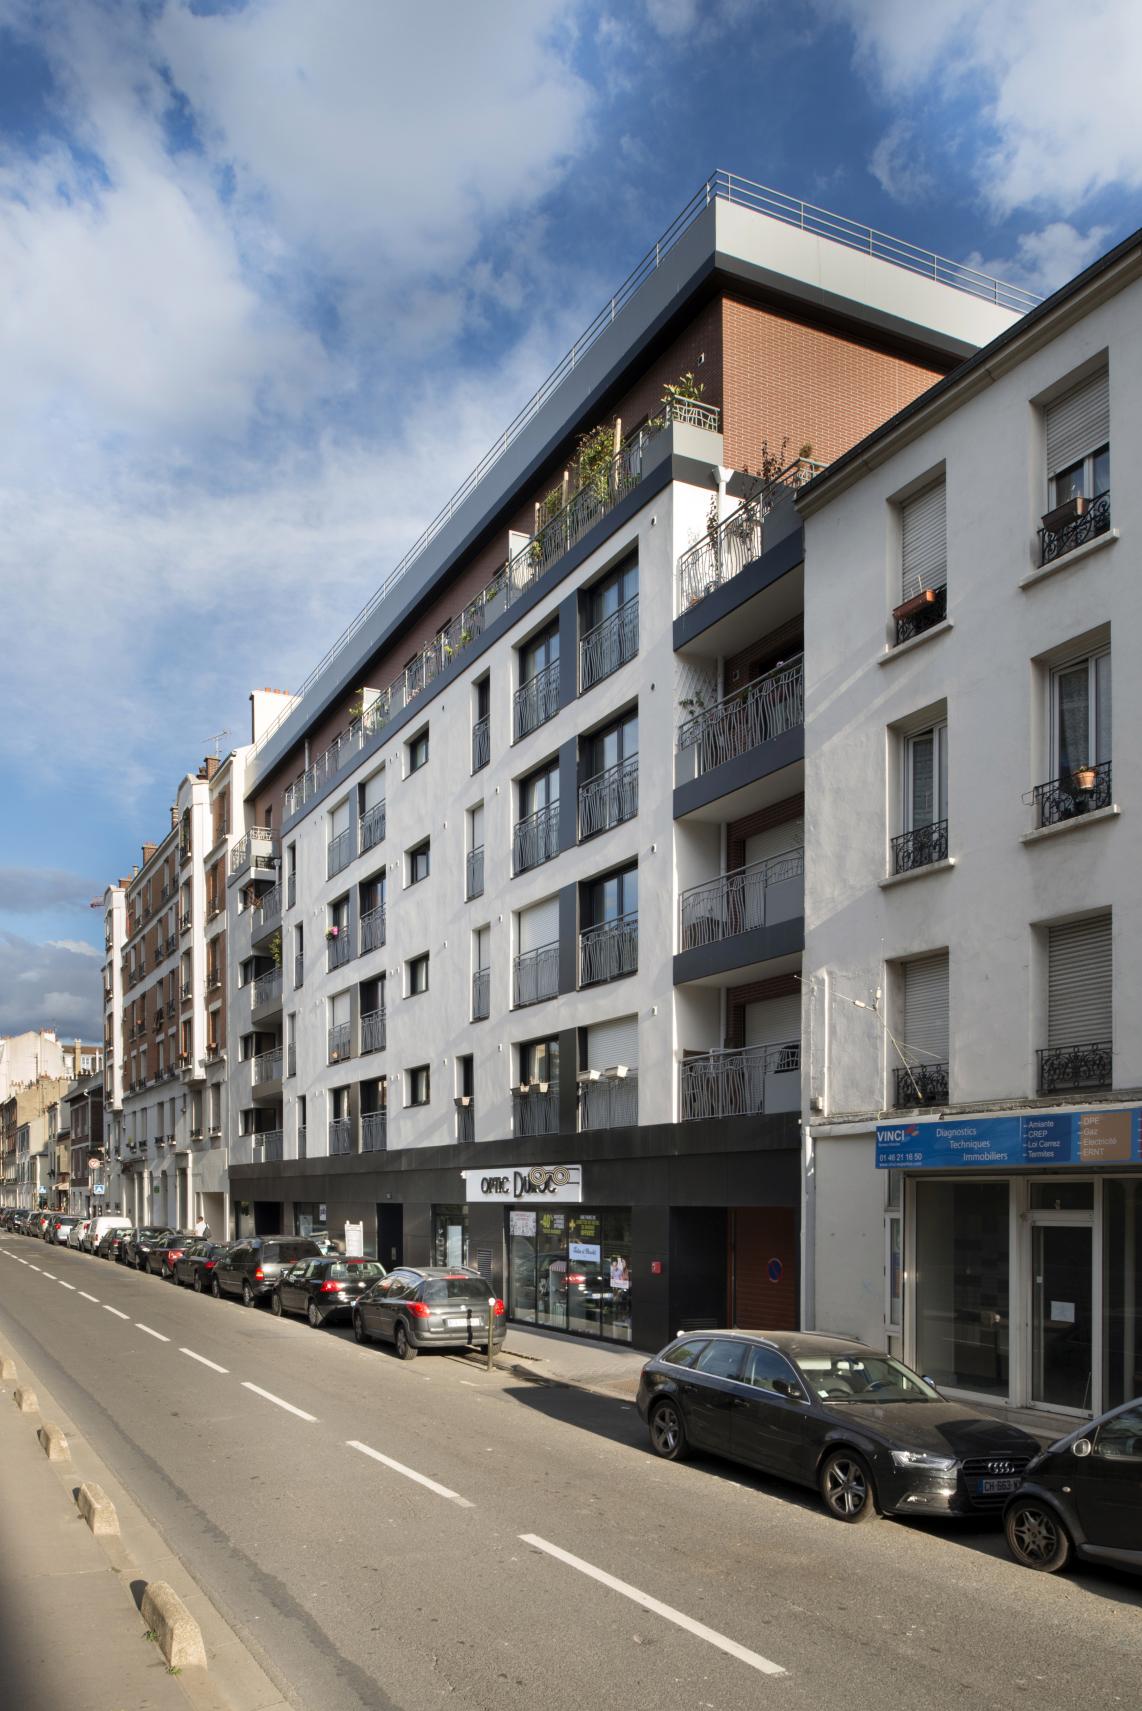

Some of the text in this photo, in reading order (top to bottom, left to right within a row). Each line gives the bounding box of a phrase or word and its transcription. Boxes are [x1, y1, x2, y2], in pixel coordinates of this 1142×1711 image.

[1028, 1120, 1054, 1128] Amiante
[1084, 1117, 1100, 1125] DPE
[877, 1130, 905, 1142] VINCI
[936, 1128, 977, 1139] Diagnostics
[1028, 1130, 1048, 1138] CREP
[1084, 1128, 1098, 1136] Gaz
[950, 1140, 991, 1150] Techniques
[963, 1151, 1008, 1161] Immobiliers
[481, 1176, 510, 1194] OPTIC
